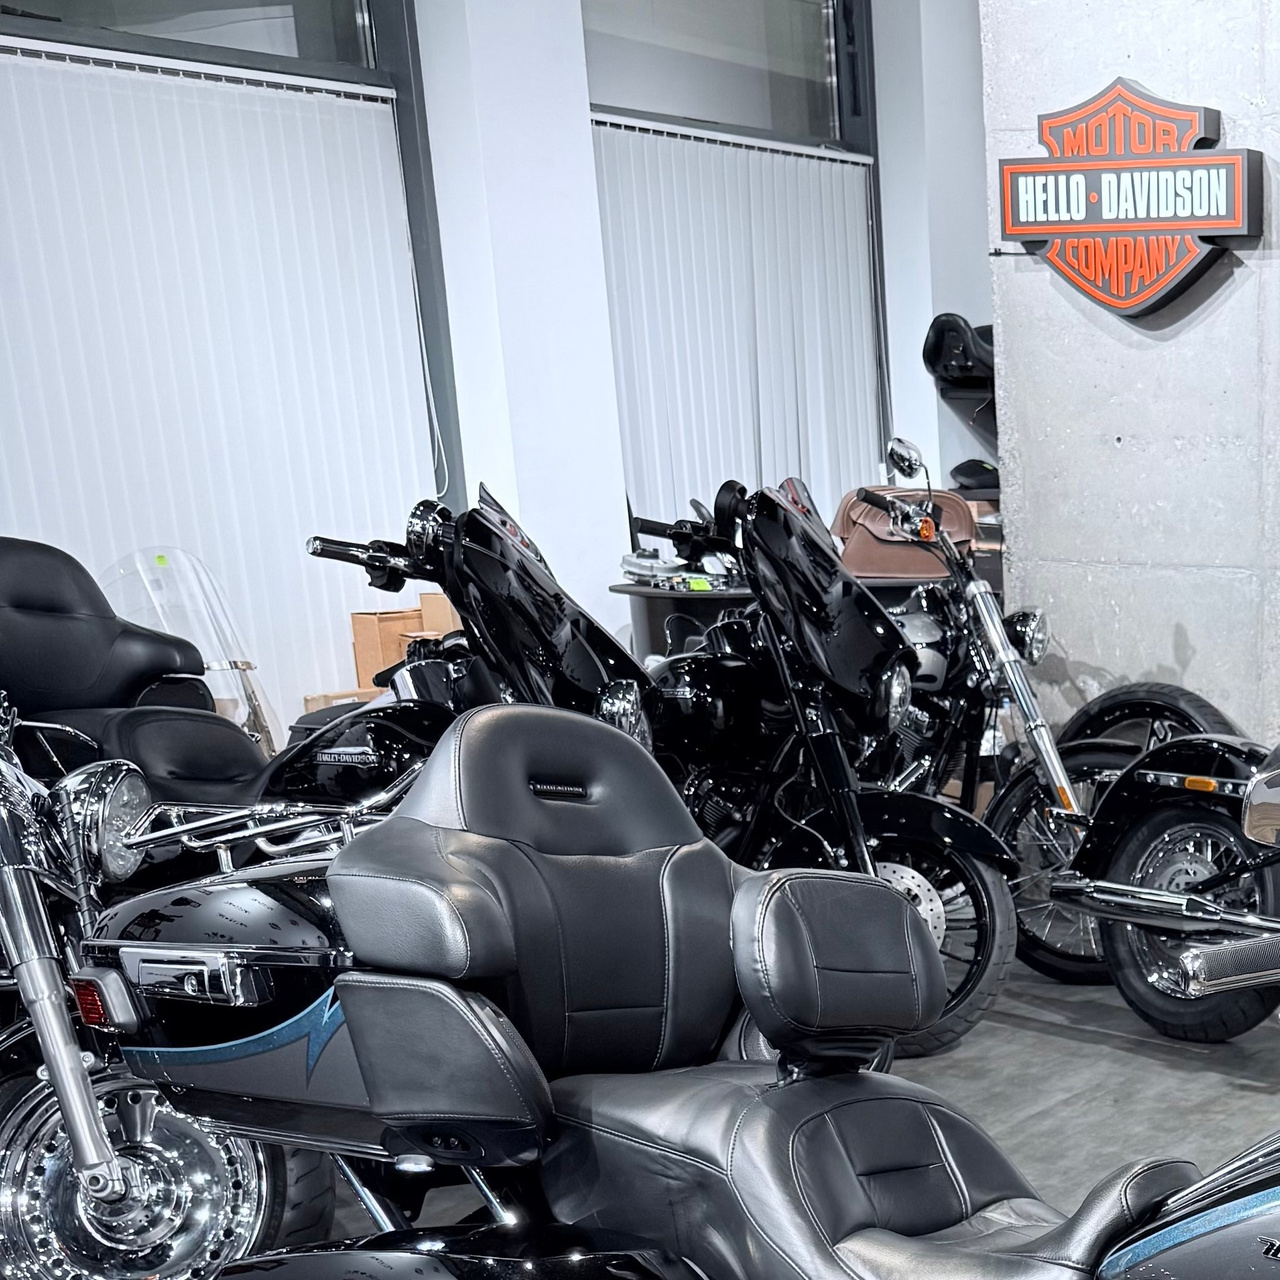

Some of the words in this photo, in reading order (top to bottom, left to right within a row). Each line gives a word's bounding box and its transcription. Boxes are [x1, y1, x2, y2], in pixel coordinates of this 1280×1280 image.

[1063, 101, 1178, 157] MOTOR
[1018, 174, 1086, 222] HELLO
[1101, 169, 1227, 220] DAVIDSON
[1065, 235, 1181, 297] COMPANY
